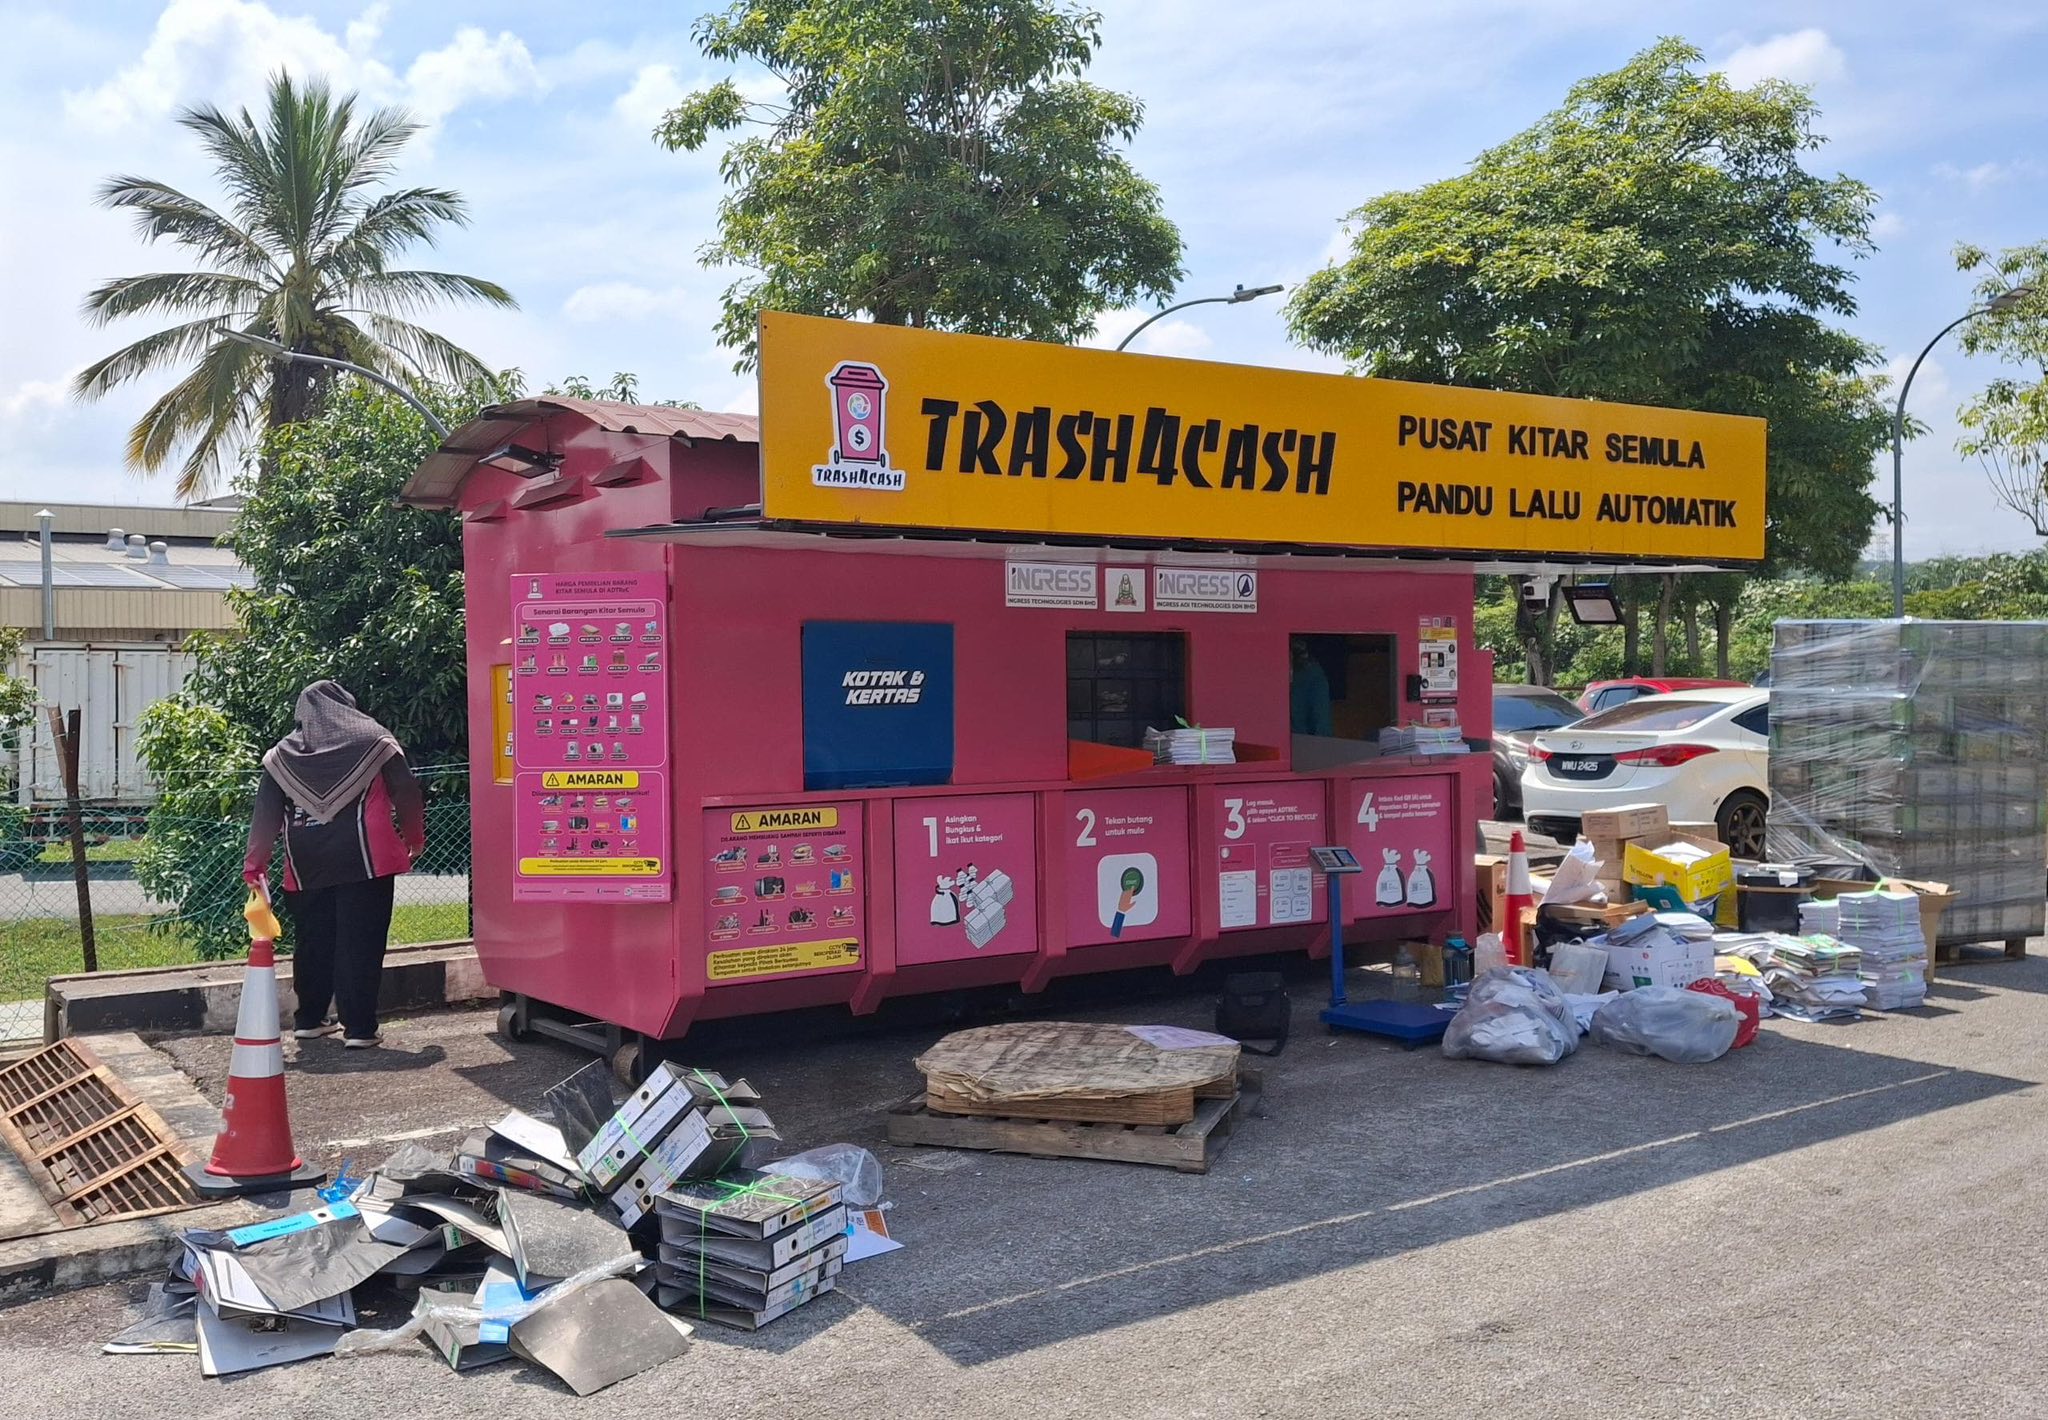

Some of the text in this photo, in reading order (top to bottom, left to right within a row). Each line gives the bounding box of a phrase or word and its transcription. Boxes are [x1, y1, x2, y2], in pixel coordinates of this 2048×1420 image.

[921, 397, 1337, 496] TRASH4CASH
[1398, 414, 1706, 469] PUSAT KITAR SEMULA
[816, 466, 902, 488] TRASH4CASH
[1397, 481, 1737, 528] PANDU LALU AUTOMATIK
[533, 606, 645, 616] Senarai Barangan Kitar Semula
[842, 670, 925, 687] KOTAK &
[845, 688, 922, 705] KERTAS
[566, 773, 624, 785] AMARAN
[758, 811, 821, 827] AMARAN
[945, 815, 977, 824] Asingkan
[1105, 815, 1153, 825] Tekan butang
[1224, 798, 1245, 839] 3
[1357, 792, 1379, 832] 4
[945, 824, 982, 834] Bungkus &
[1076, 808, 1096, 847] 2
[1104, 826, 1145, 836] untuk mula
[923, 817, 938, 857] 1
[975, 833, 1003, 844] kategori
